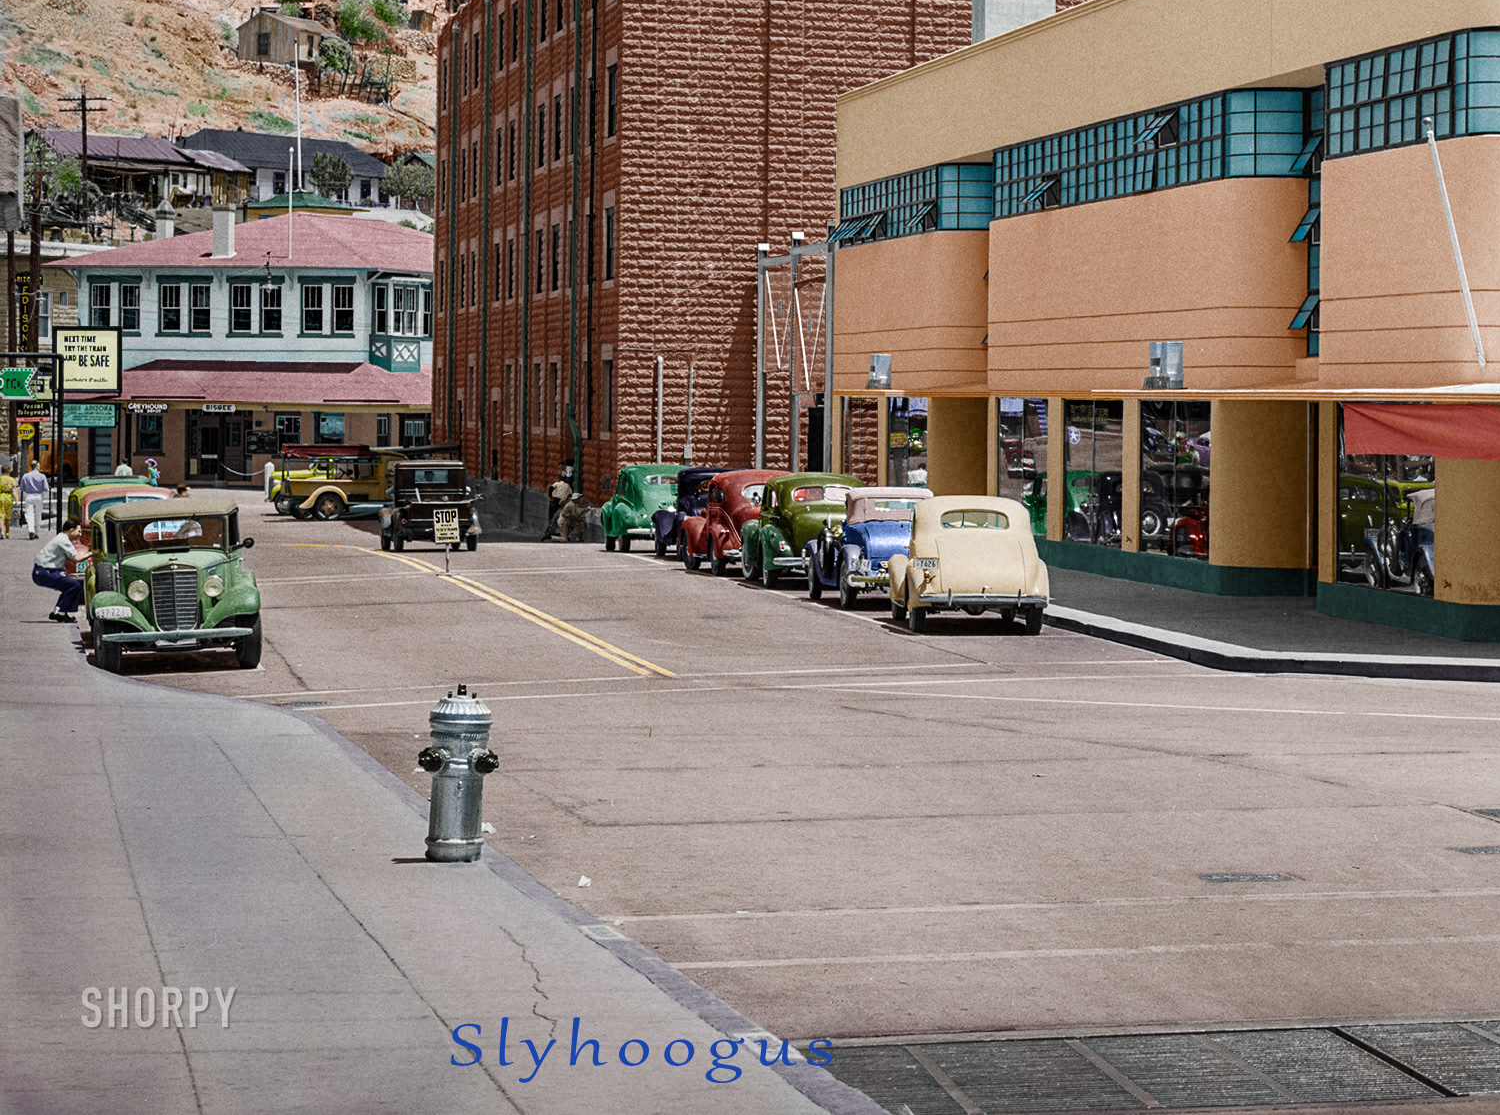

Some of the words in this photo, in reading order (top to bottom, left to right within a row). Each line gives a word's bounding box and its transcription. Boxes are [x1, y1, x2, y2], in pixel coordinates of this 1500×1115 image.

[21, 286, 29, 342] EDISON
[79, 355, 89, 367] BE
[90, 355, 110, 367] SAFE
[435, 511, 457, 523] STOP
